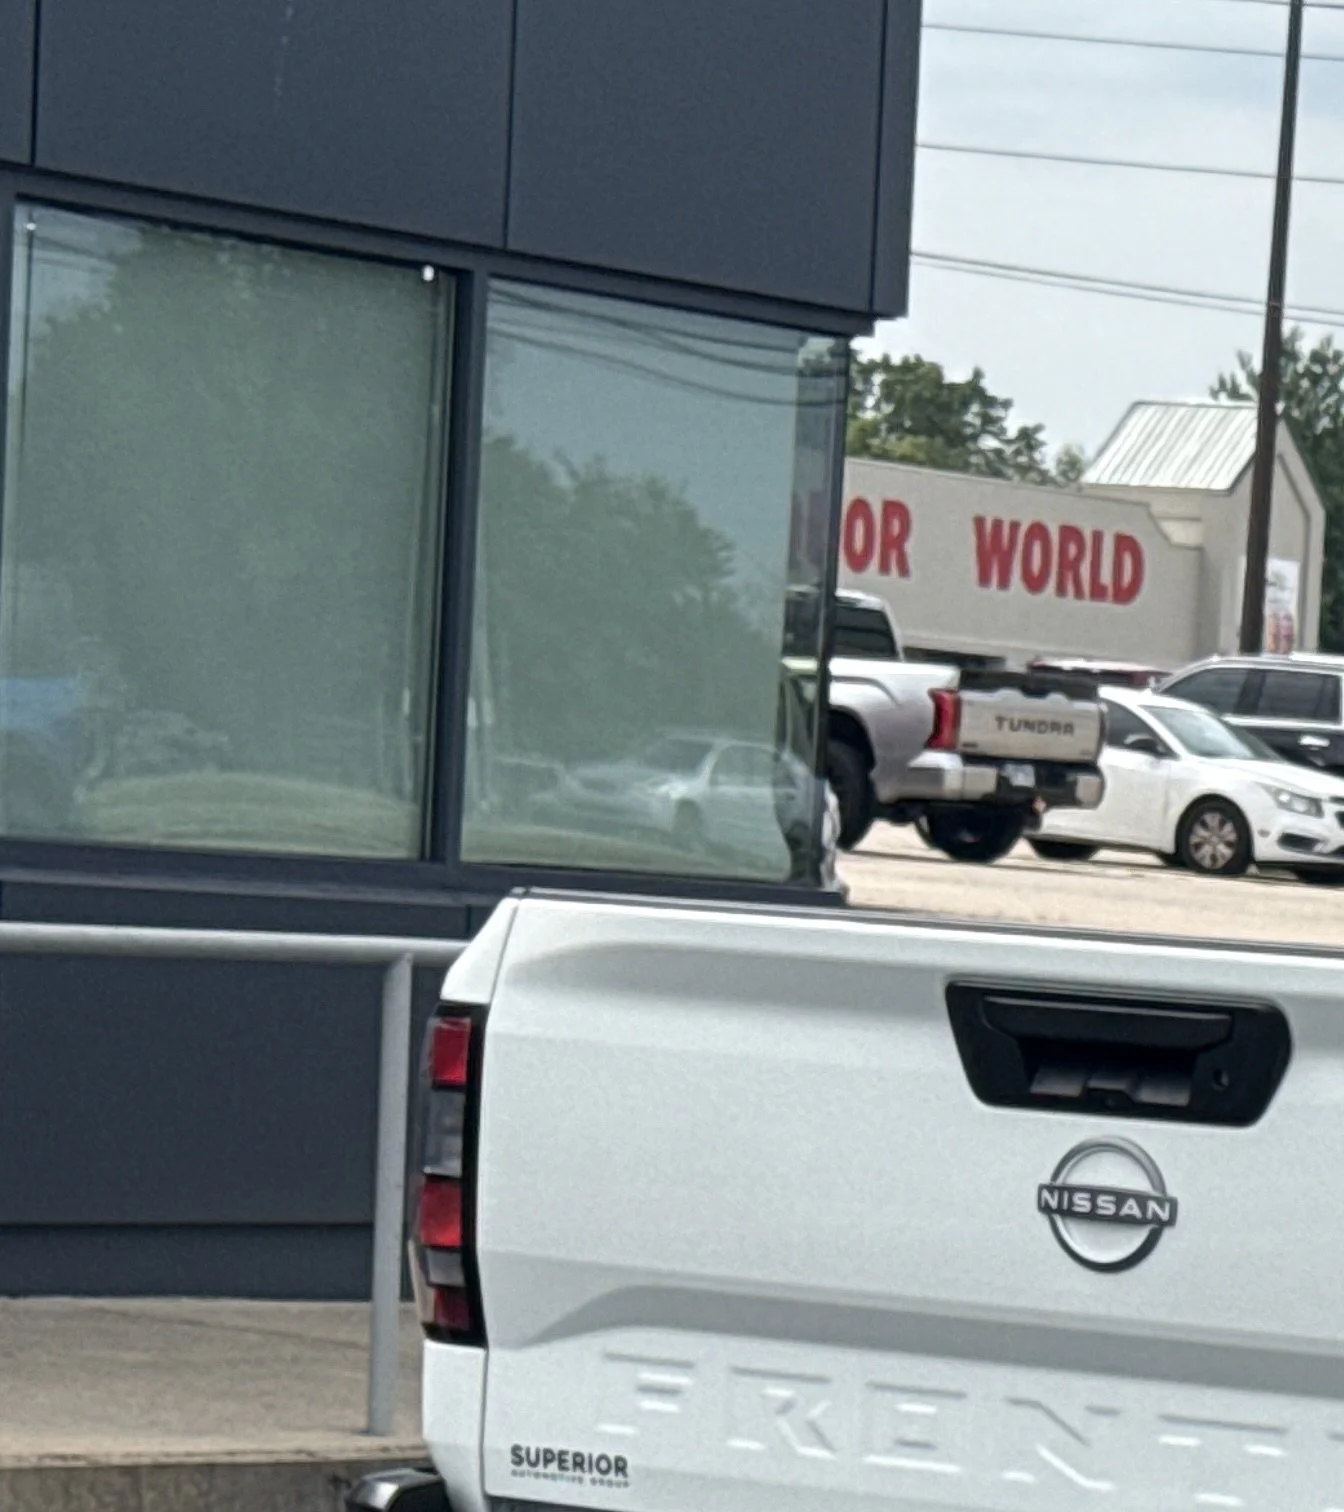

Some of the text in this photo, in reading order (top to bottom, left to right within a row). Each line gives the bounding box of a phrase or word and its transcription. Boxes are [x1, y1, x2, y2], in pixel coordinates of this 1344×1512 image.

[974, 515, 1144, 606] WORLD
[995, 716, 1075, 736] TUNDRA
[1040, 1188, 1170, 1222] NISSAN
[510, 1443, 629, 1479] SUPERIOR
